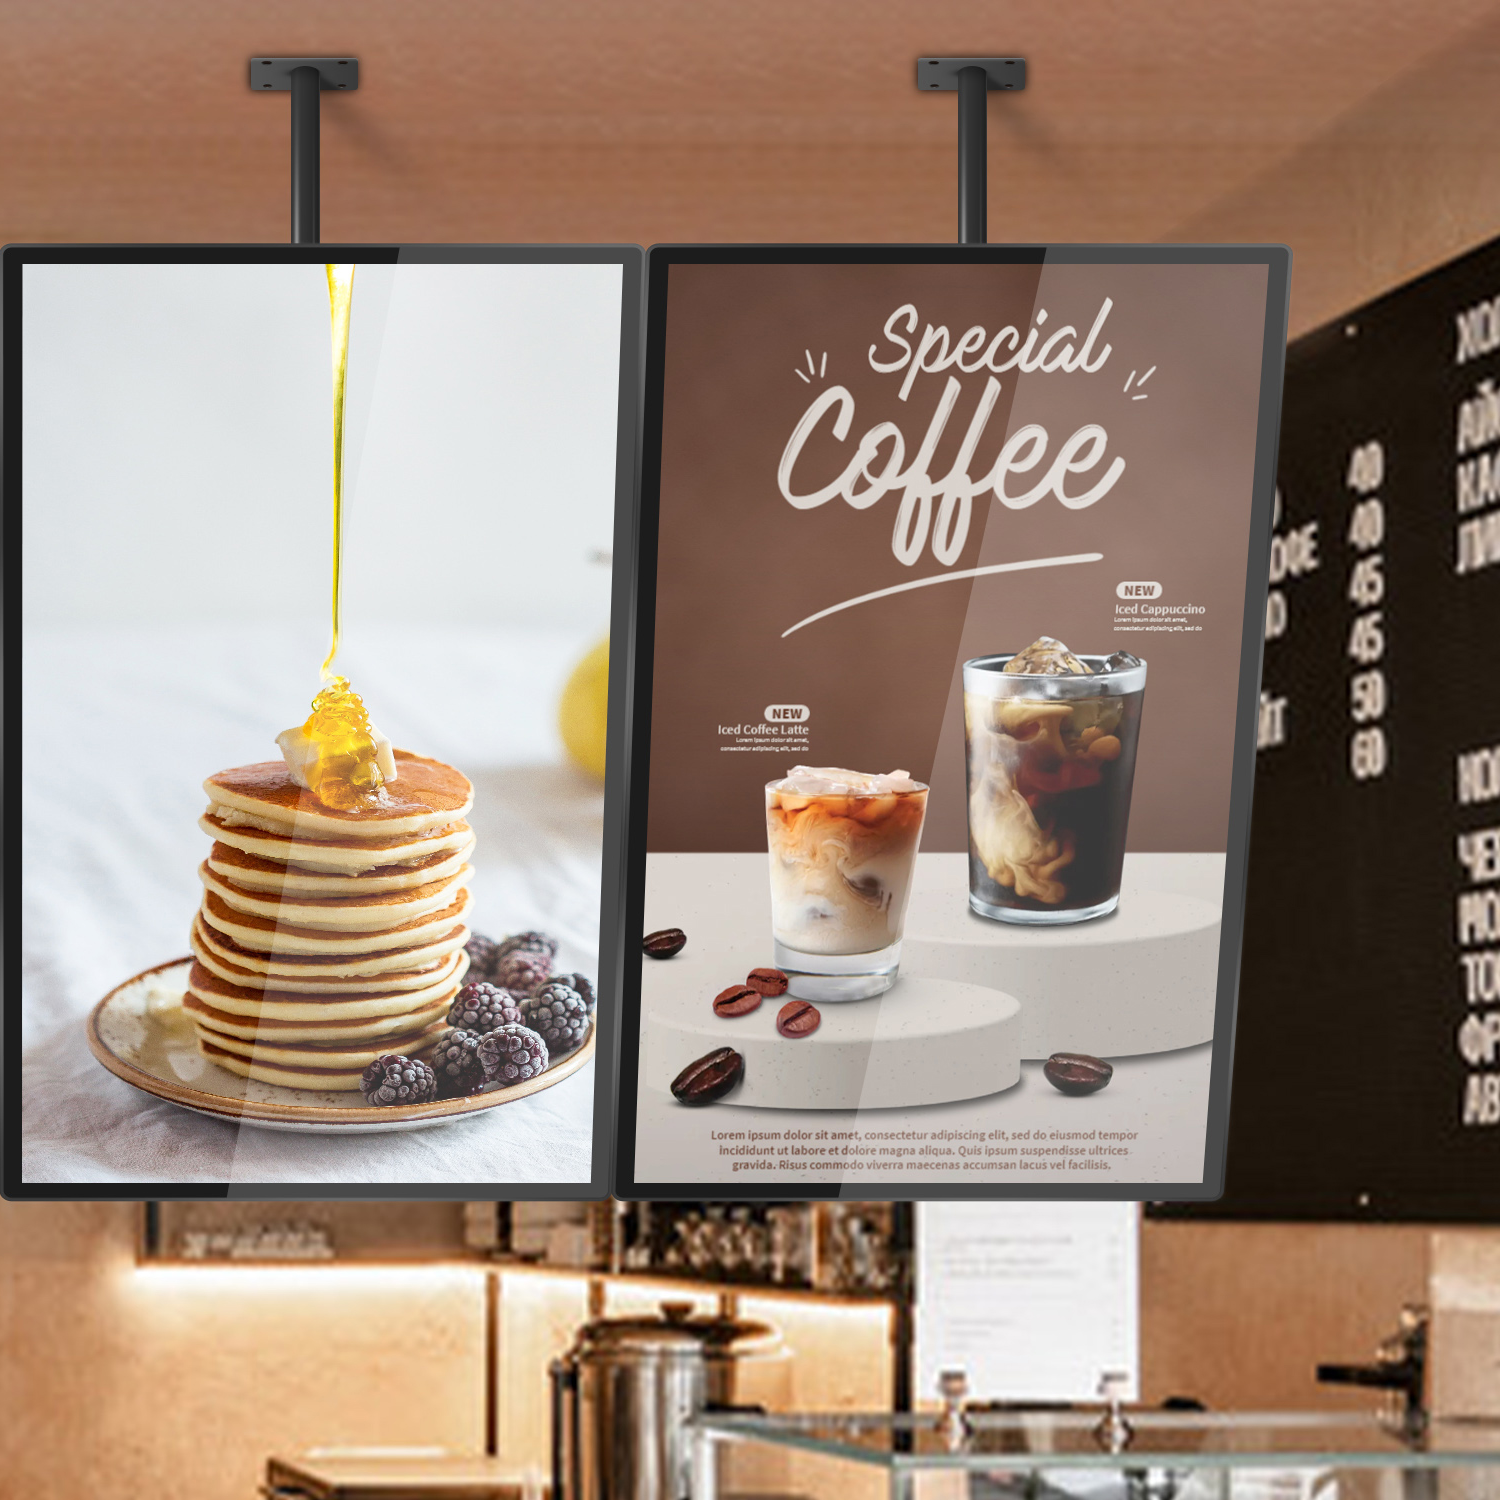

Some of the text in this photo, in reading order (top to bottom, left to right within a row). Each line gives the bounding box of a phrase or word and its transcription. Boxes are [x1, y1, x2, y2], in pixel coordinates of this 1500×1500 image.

[868, 297, 1113, 402] Special
[777, 375, 1127, 566] Coffee
[1348, 554, 1385, 607] 45
[1124, 585, 1155, 597] NEW
[1115, 603, 1206, 616] Iced Cappuccino
[1348, 611, 1385, 665] 45
[772, 708, 803, 719] NEW
[718, 724, 809, 735] Iced Coffee Latte
[711, 1130, 1138, 1142] Lorem ipsum dolor sit amet, consectetur adipiscing elit, sed do eiusmod tempor
[719, 1145, 1129, 1157] incididunt ut labore et dolore magna aliqua. Quis ipsum suspendisse ultrices
[732, 1160, 1111, 1172] gravida. Risus commodo viverra maecenas accumsan lacus vel facilisis.
